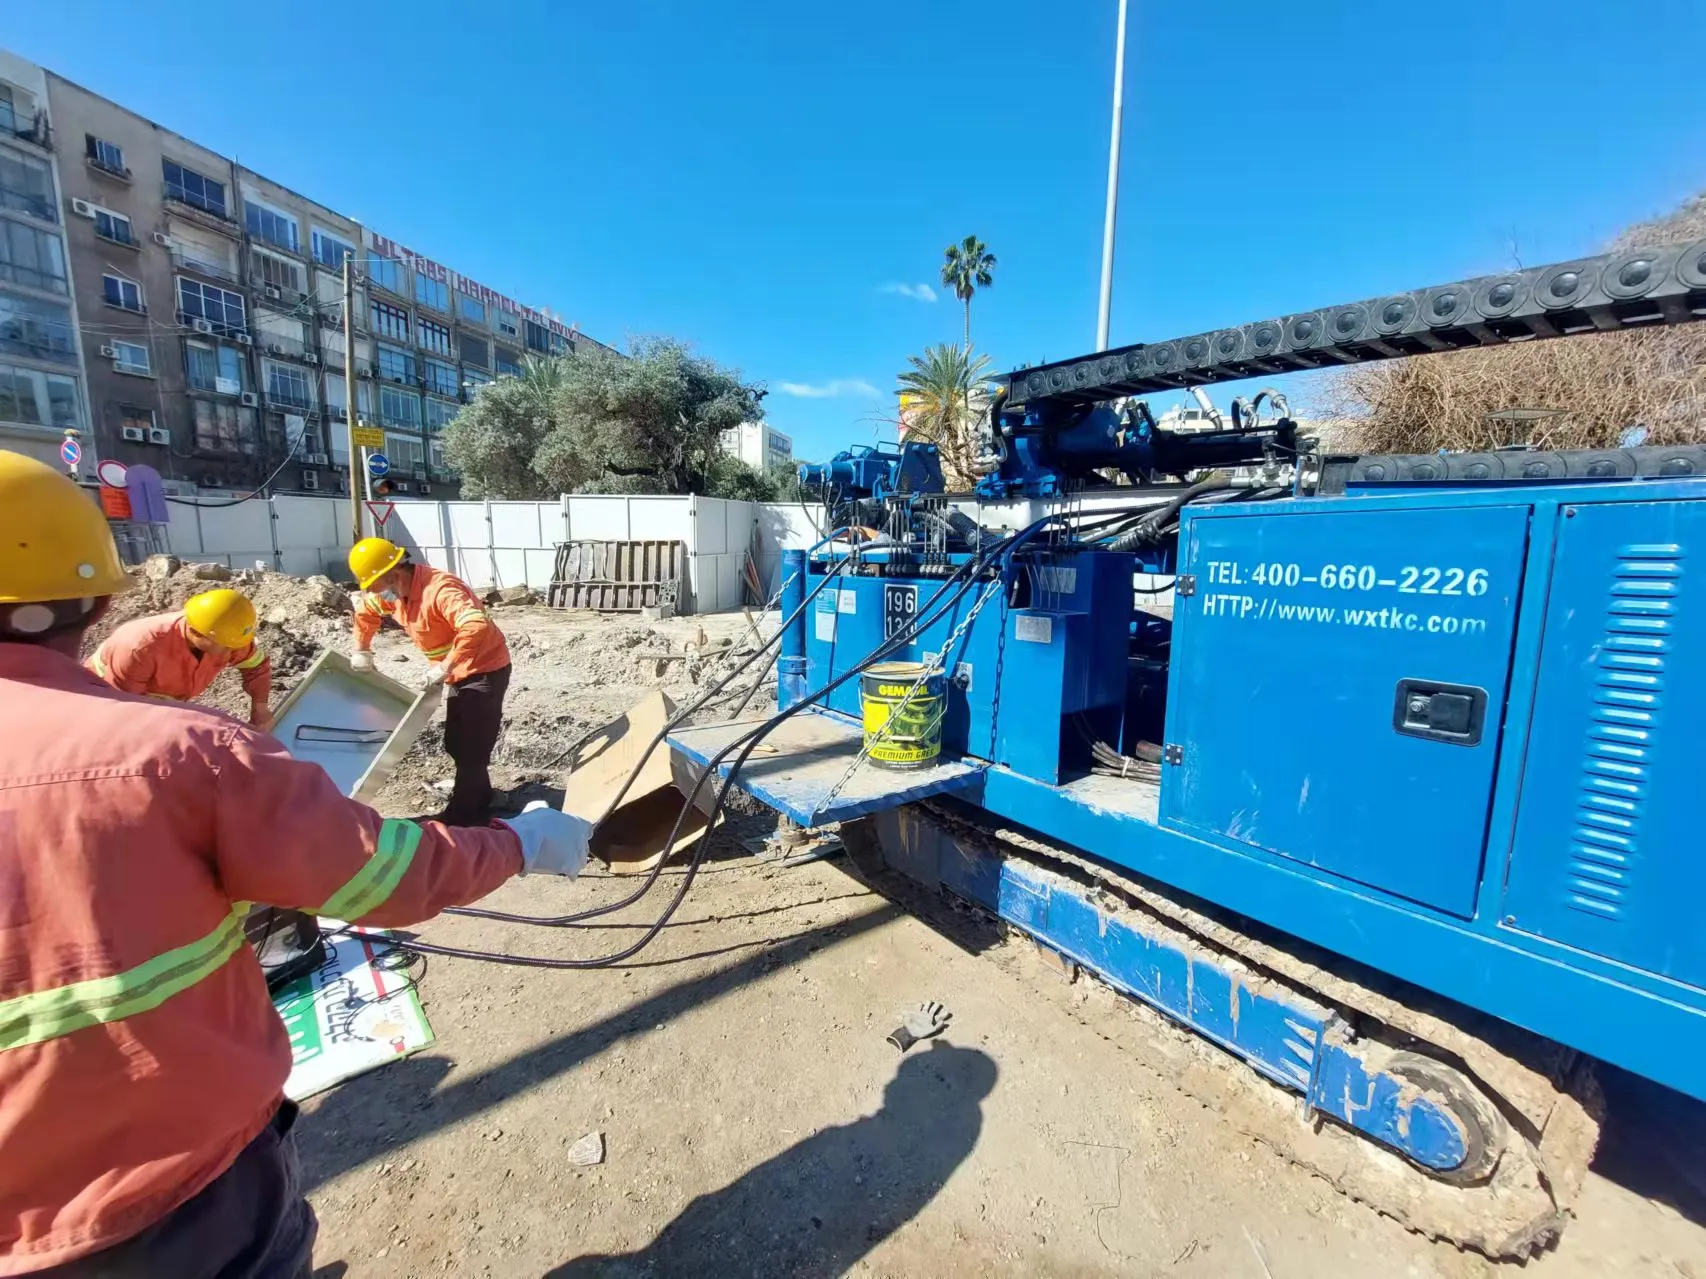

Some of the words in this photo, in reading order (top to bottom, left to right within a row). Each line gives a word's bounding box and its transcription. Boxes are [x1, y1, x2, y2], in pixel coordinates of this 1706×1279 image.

[887, 590, 914, 613] 196
[1203, 594, 1487, 634] HTTP://www.wxtkc.com
[873, 750, 914, 760] PREMIUM
